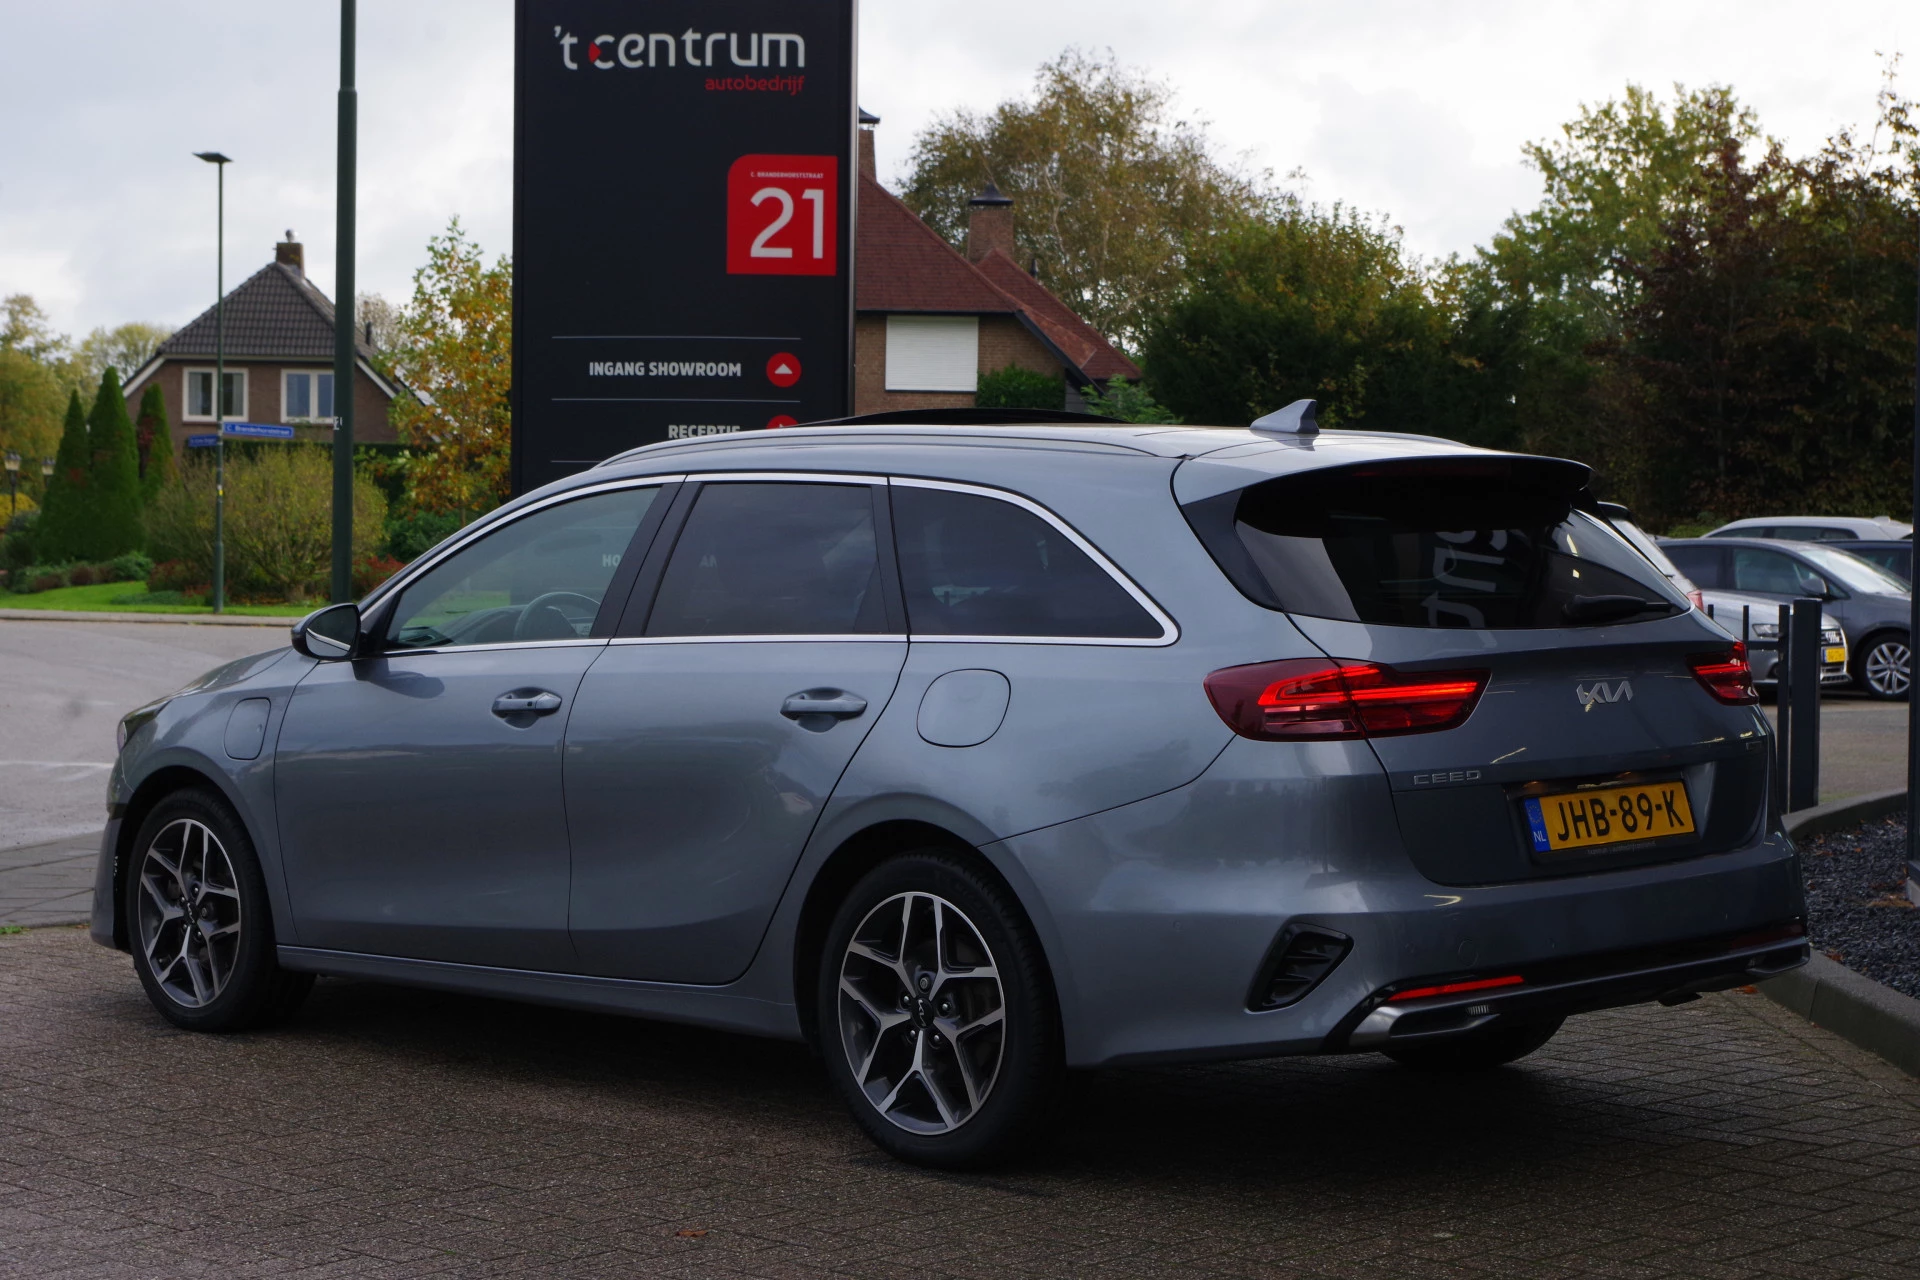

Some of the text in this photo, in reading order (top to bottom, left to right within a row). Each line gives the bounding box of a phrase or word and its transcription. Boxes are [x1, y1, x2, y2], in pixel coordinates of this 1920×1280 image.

[554, 25, 806, 70] 't centrum
[704, 75, 805, 95] autobedrijf
[750, 187, 824, 259] 21
[589, 361, 741, 377] INGANG SHOWROOM
[1413, 770, 1482, 785] CEED
[1533, 790, 1685, 843] NL JHB-89-K
